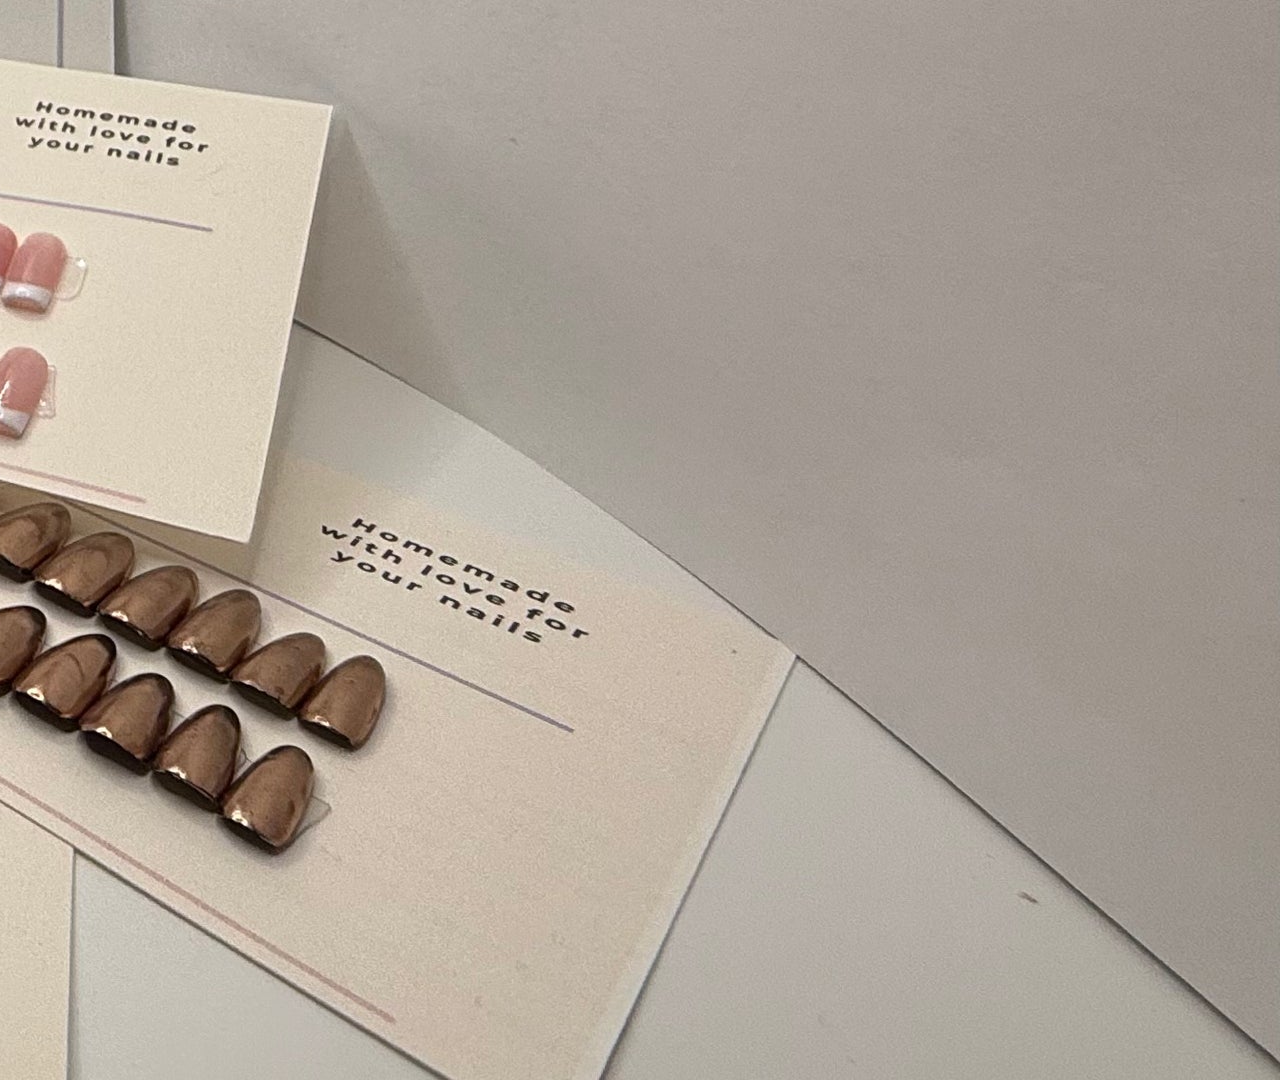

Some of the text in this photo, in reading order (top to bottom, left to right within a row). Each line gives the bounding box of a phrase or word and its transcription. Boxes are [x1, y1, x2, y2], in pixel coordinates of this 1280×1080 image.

[15, 116, 209, 153] with love for
[35, 101, 197, 134] Homemade
[28, 136, 180, 167] your nails
[321, 524, 590, 639] with love for
[330, 550, 542, 643] your nails
[351, 518, 575, 614] Homemade
